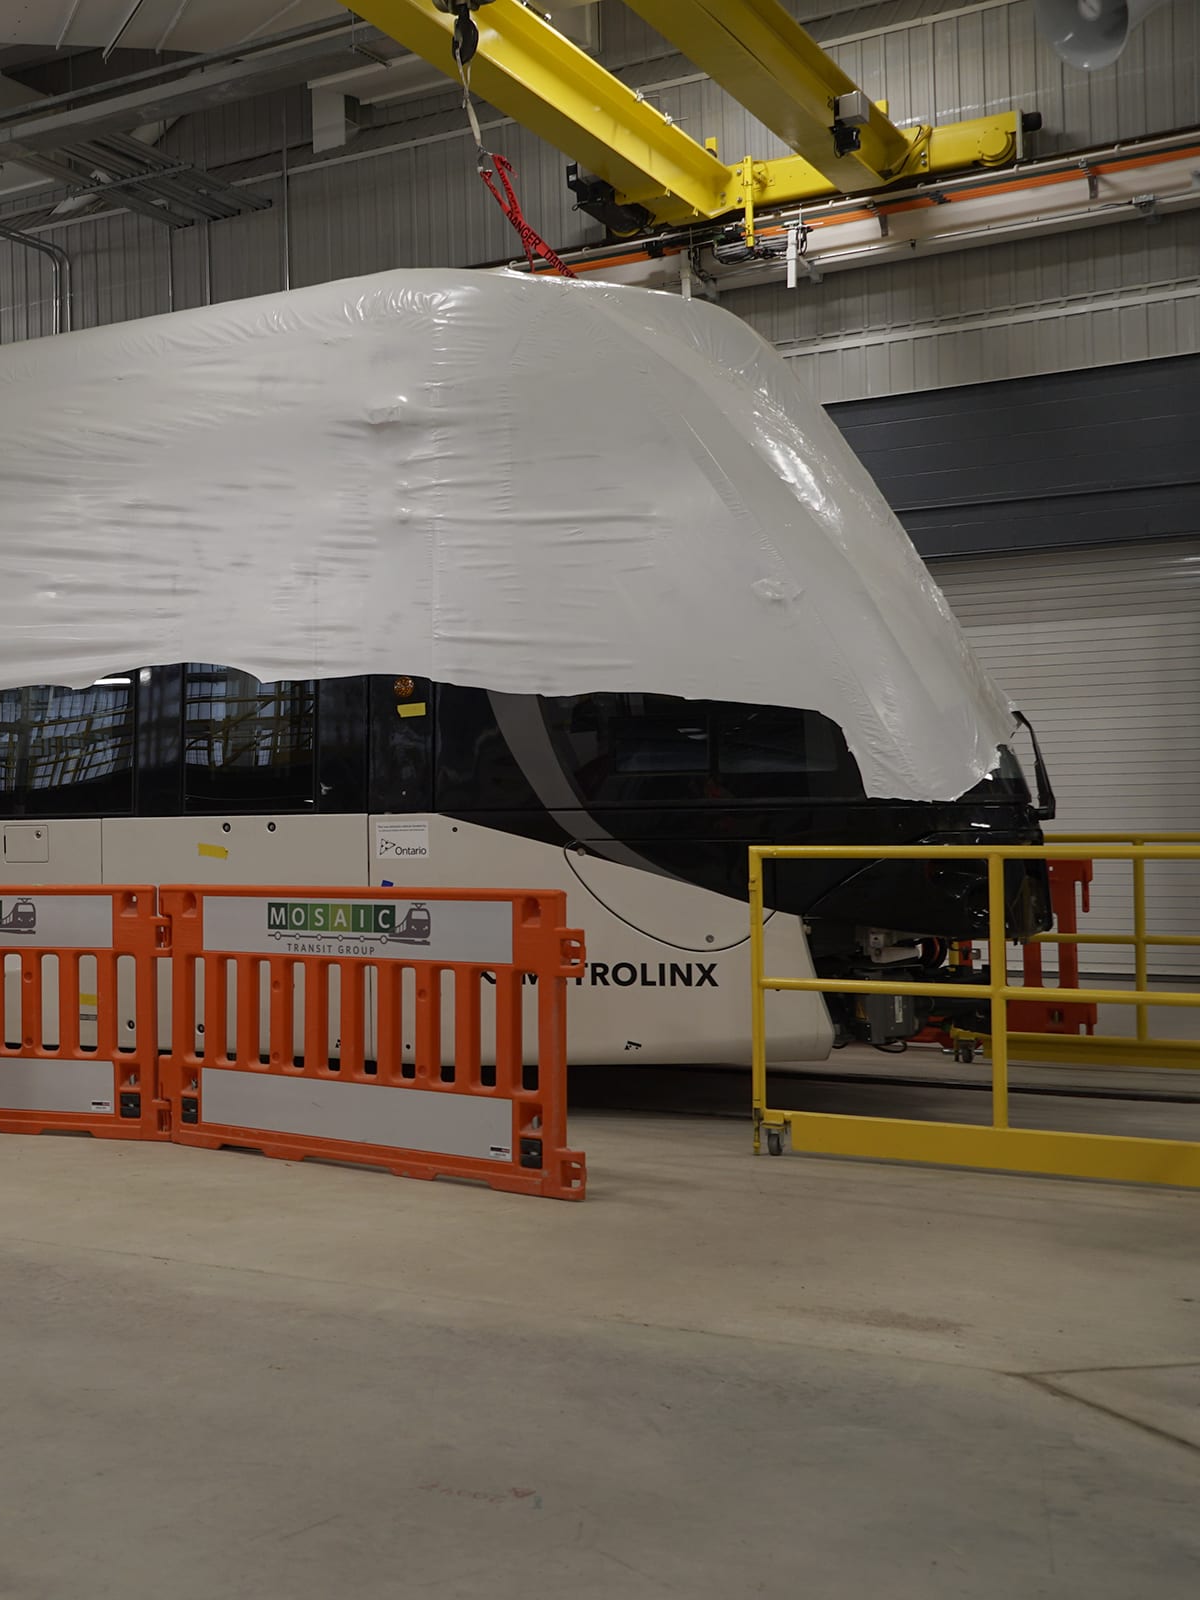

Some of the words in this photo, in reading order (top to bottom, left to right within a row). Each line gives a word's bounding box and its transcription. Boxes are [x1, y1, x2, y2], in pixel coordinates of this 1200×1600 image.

[506, 210, 542, 250] DANGER
[395, 846, 427, 856] Ontario
[270, 907, 390, 929] MOSAIC
[287, 943, 332, 953] TRANSIT
[338, 945, 375, 956] GROUP
